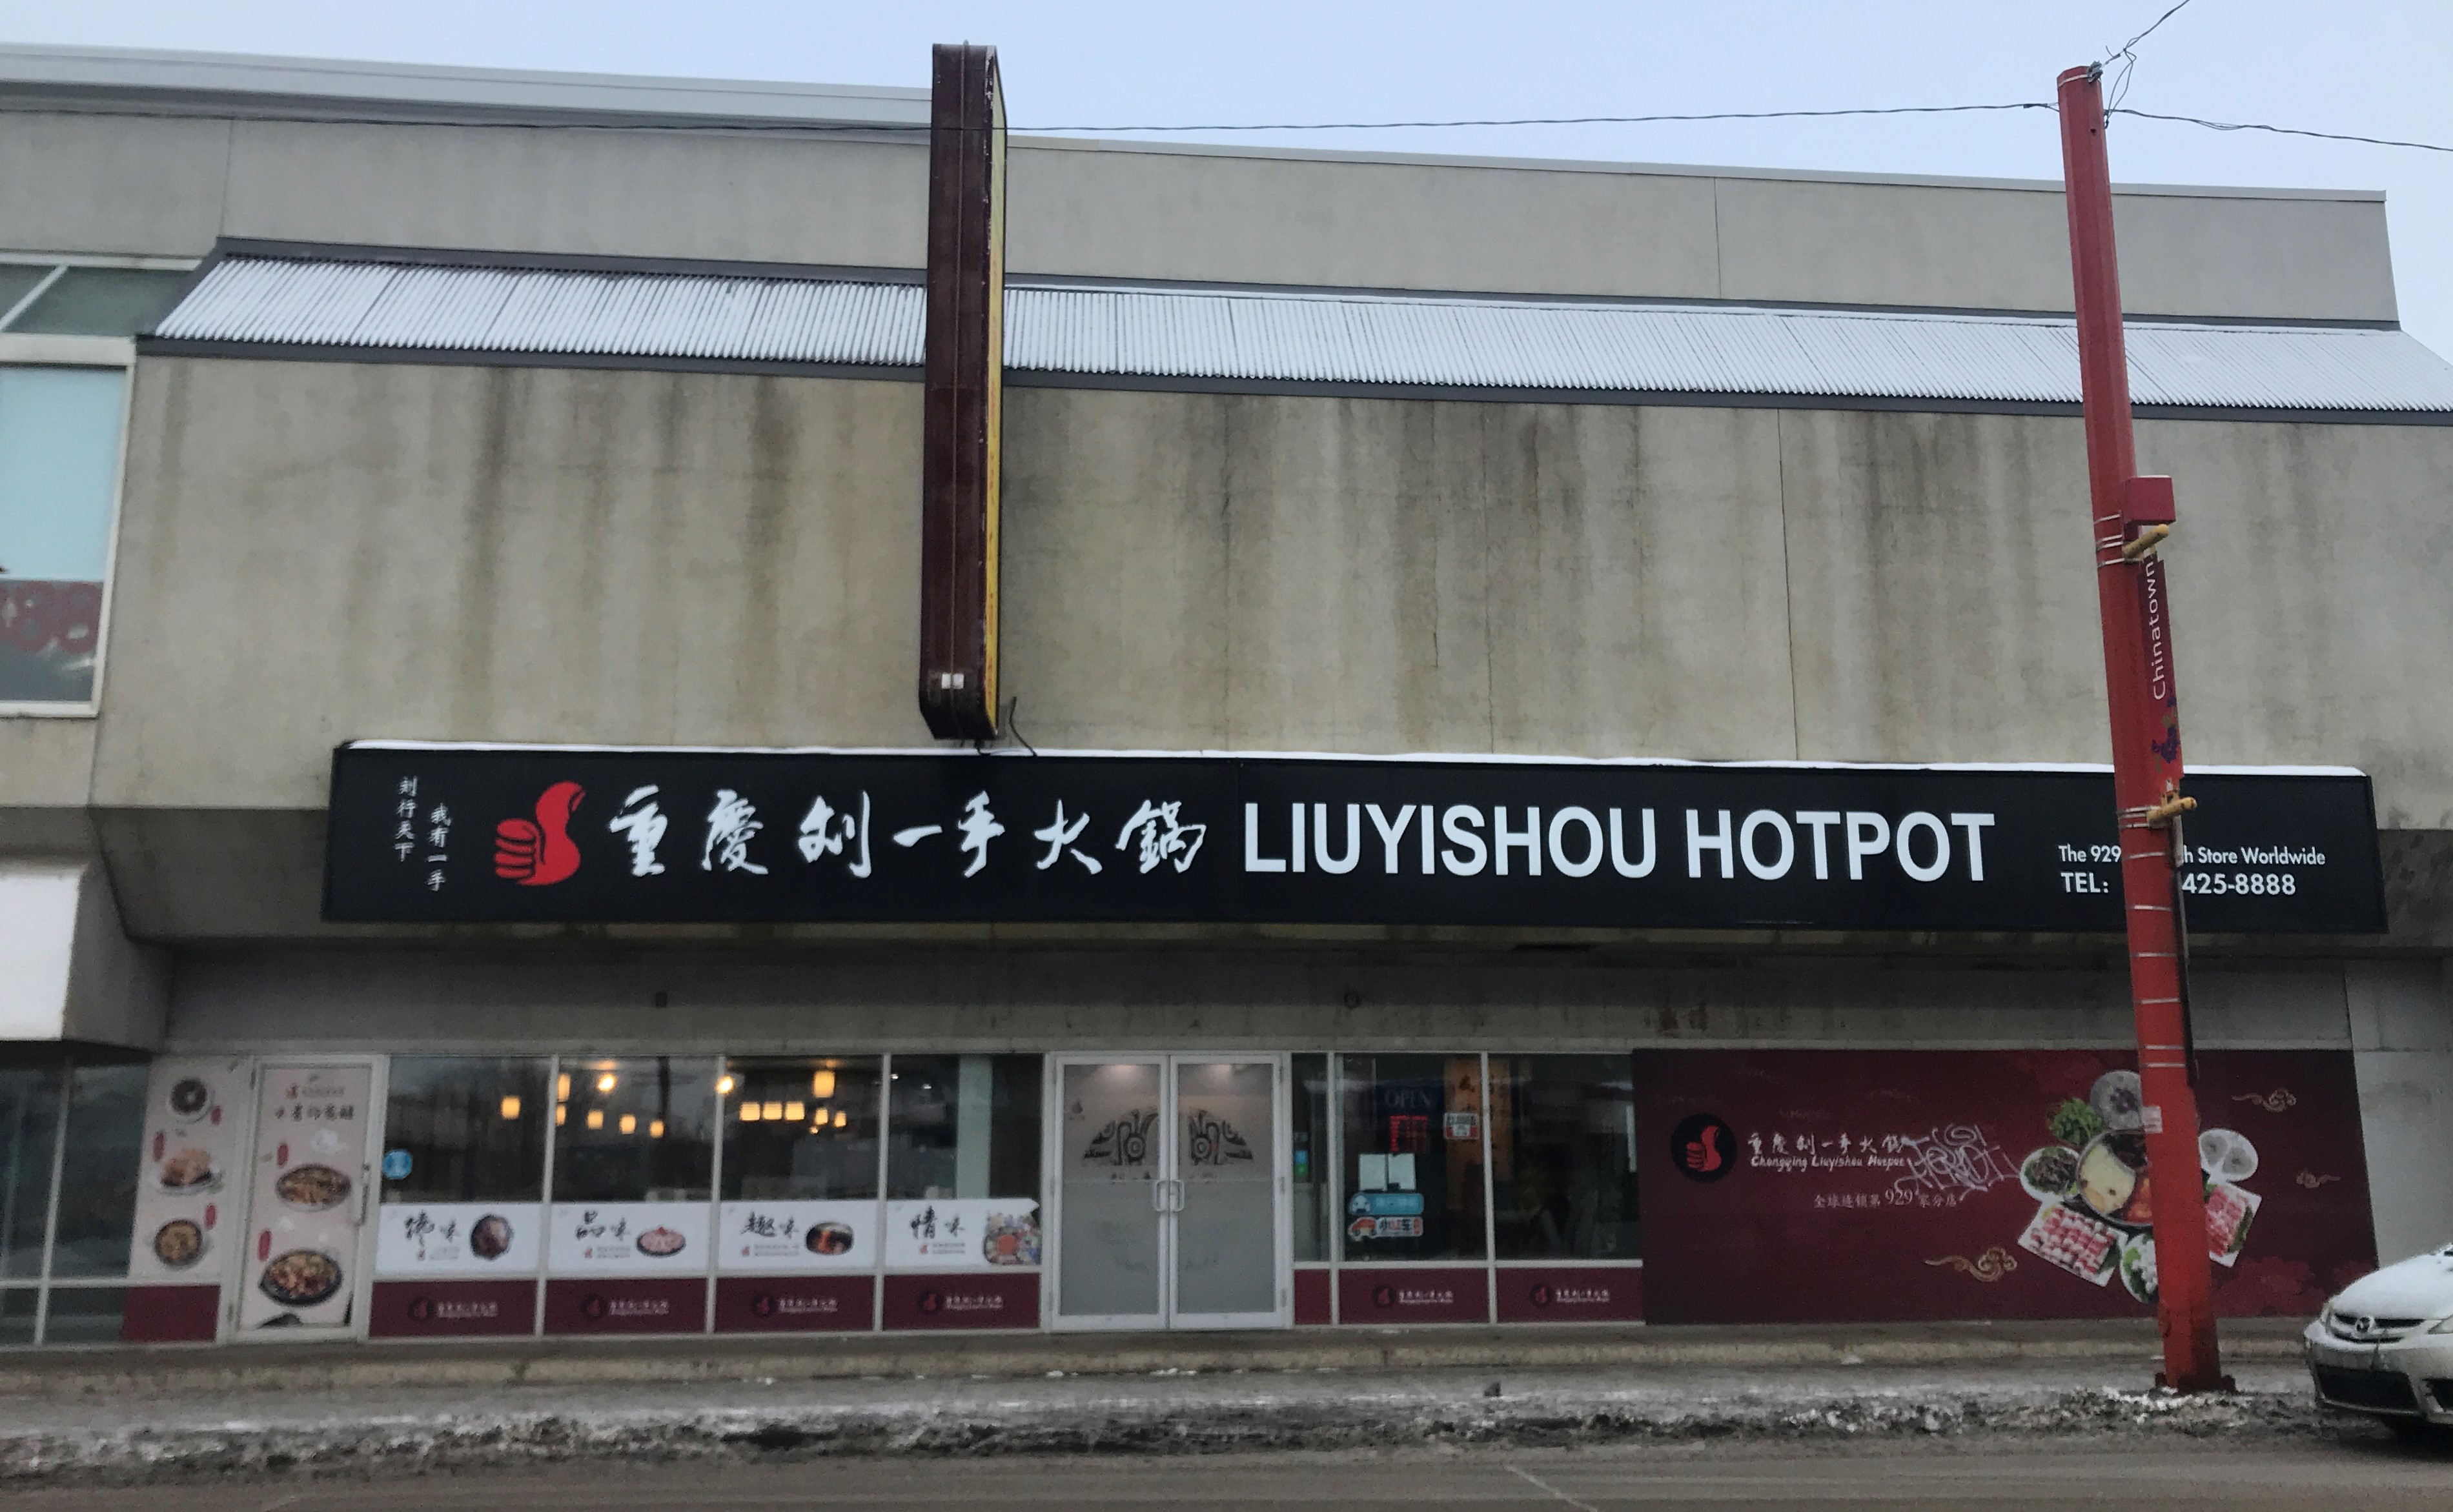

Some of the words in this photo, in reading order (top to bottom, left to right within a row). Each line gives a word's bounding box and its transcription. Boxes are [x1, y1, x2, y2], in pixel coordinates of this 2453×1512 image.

[2144, 561, 2166, 700] Chinatown
[1245, 802, 1657, 879] LIUYISHOU
[1685, 808, 1996, 883] HOTPOT
[2058, 842, 2087, 863] The
[2197, 845, 2238, 865] Store
[2240, 845, 2326, 865] Worldwide
[2061, 872, 2109, 894] TEL:
[2181, 872, 2296, 896] 425-8888
